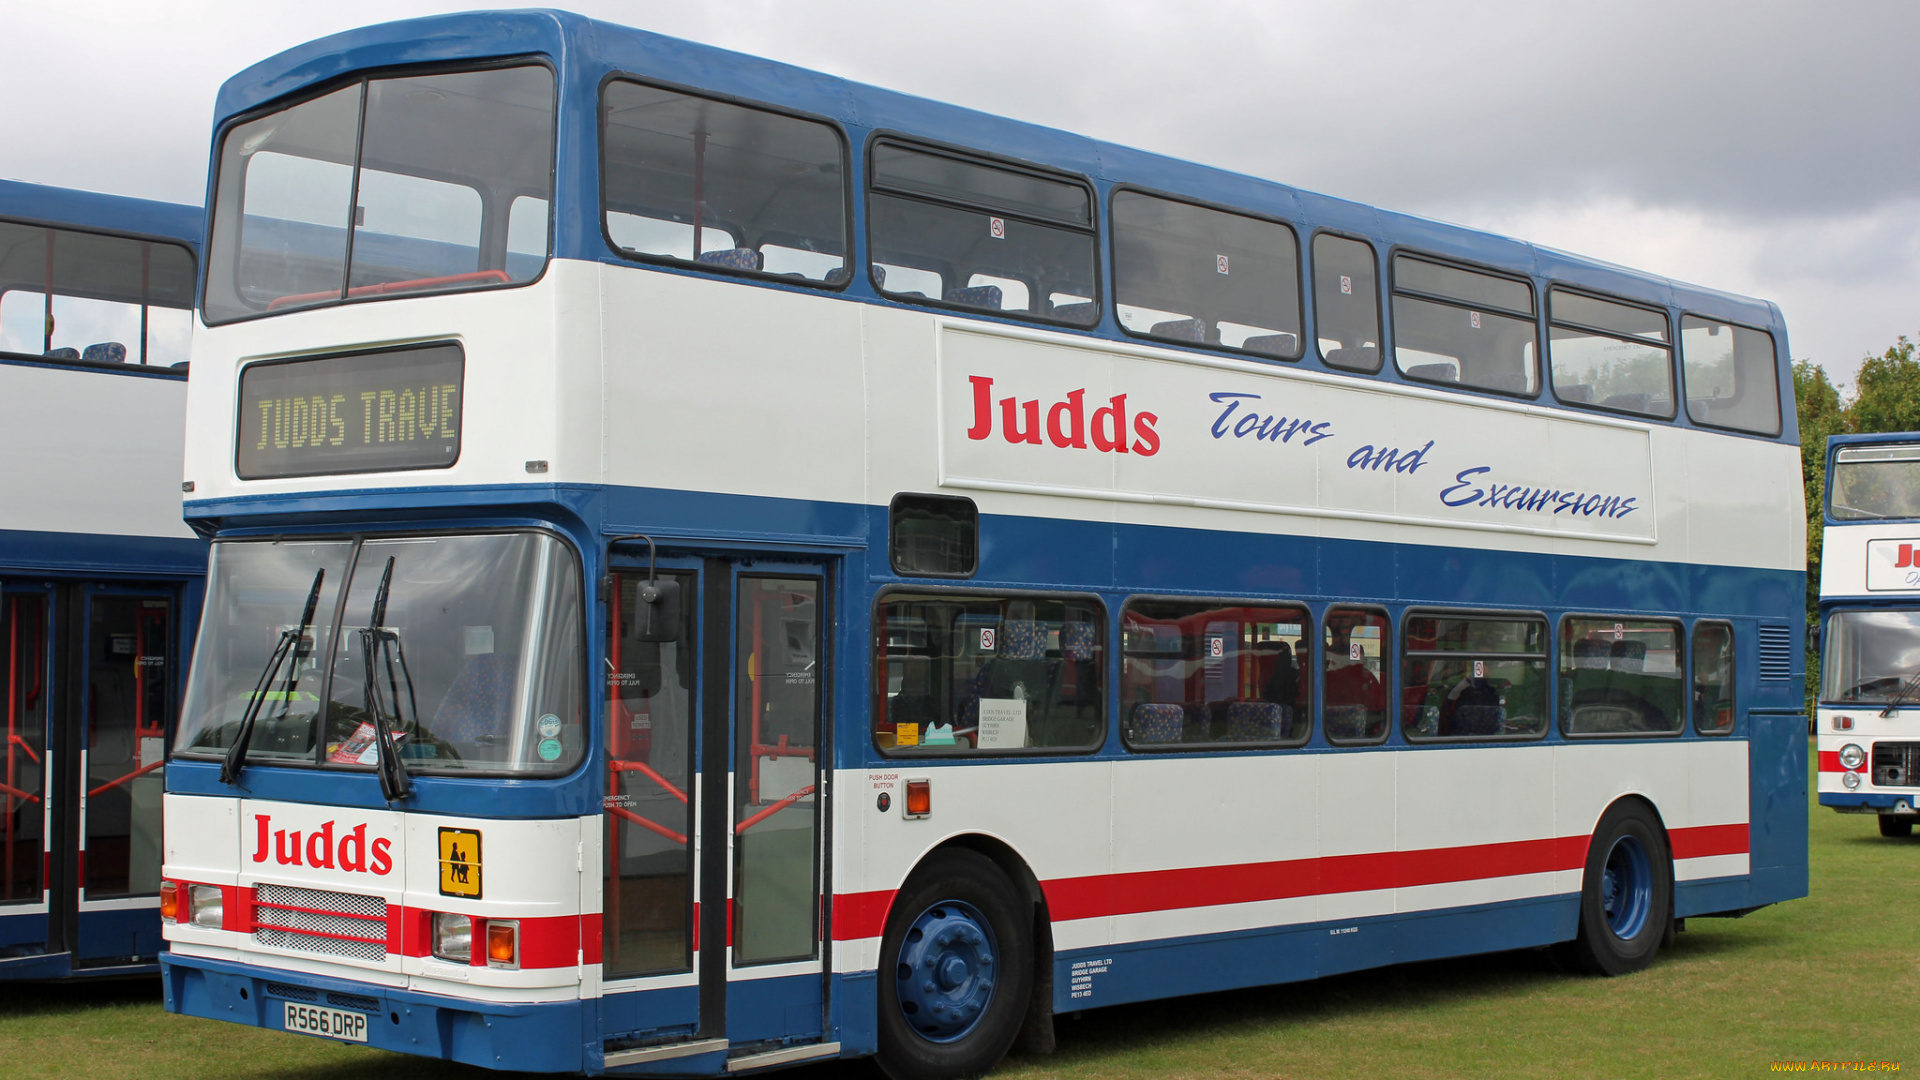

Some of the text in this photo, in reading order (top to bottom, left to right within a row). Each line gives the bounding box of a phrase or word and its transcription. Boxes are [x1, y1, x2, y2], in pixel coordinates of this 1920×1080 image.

[257, 385, 456, 450] JUDDS TRAVE
[967, 375, 1640, 519] Judds Tours and Excursions
[884, 773, 899, 781] DOOR
[253, 814, 393, 876] Judds
[1071, 966, 1107, 977] BRIDGE GARAGE
[1087, 959, 1103, 967] TRAVEL
[287, 1005, 365, 1038] R566 DRP
